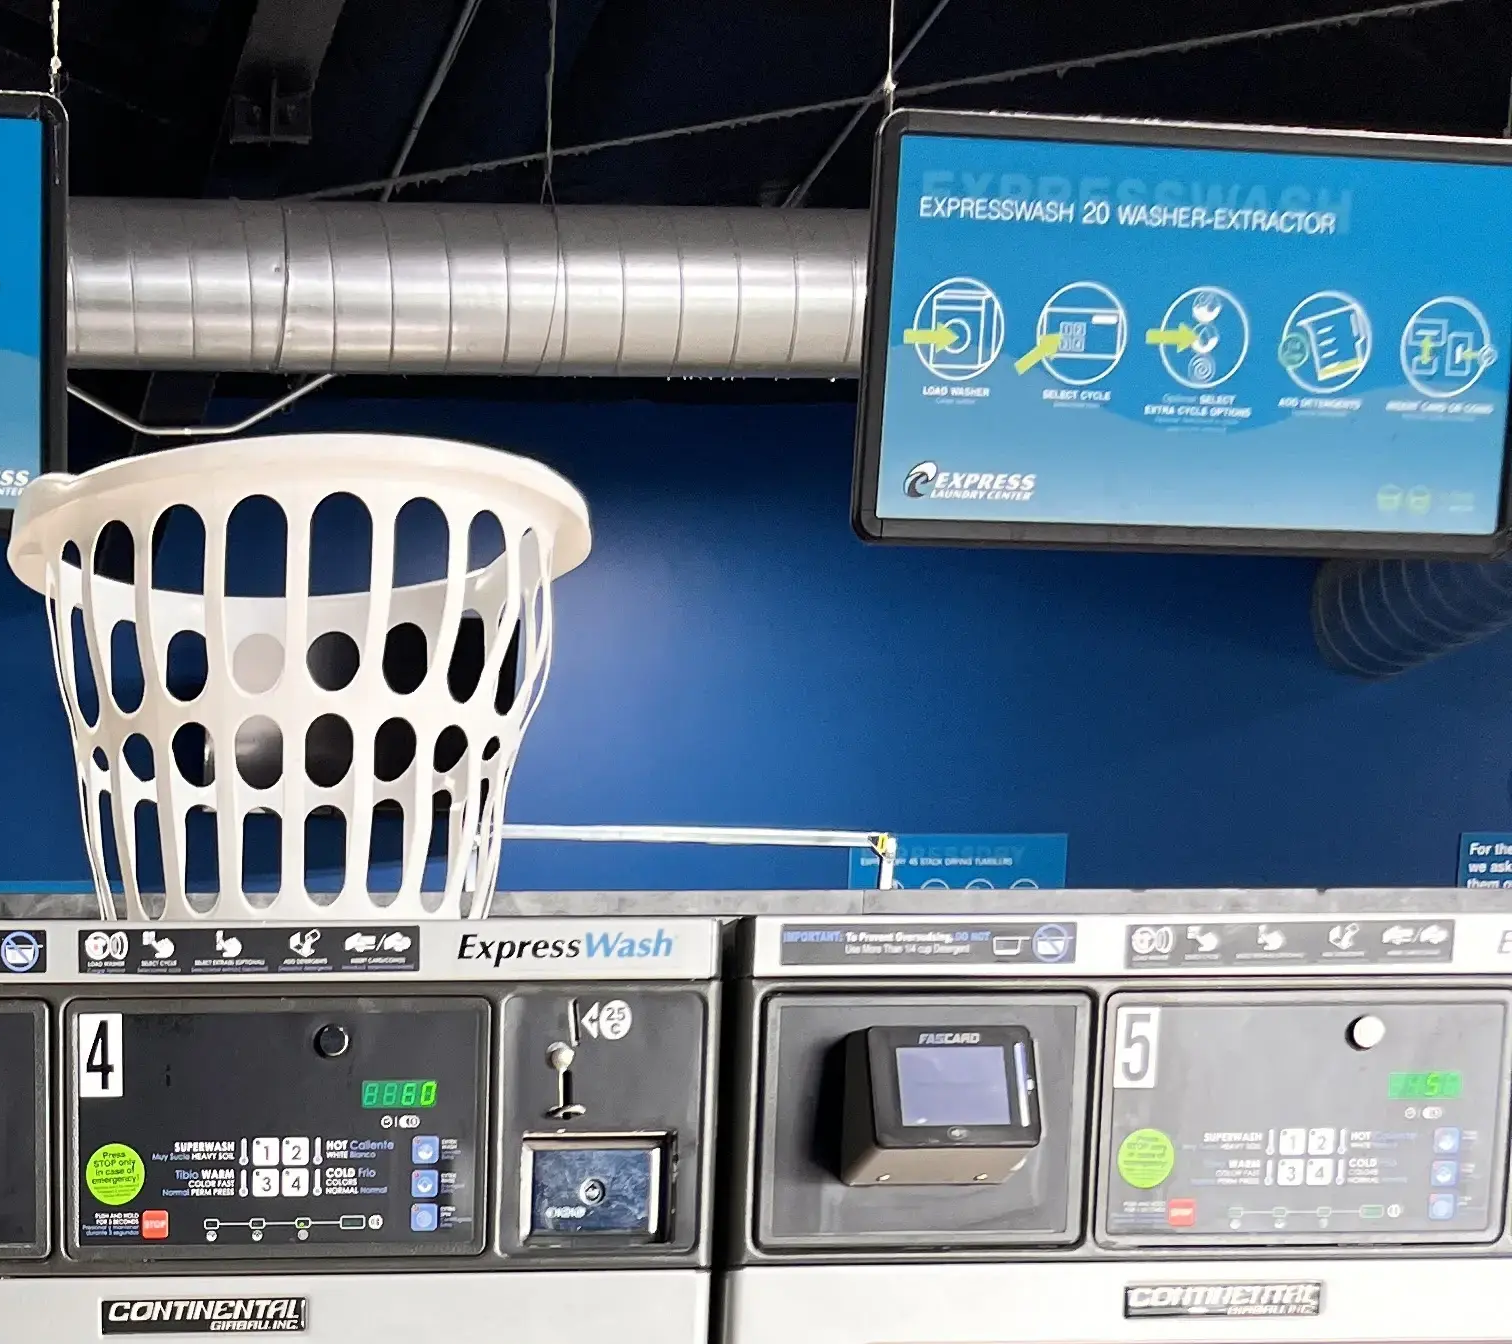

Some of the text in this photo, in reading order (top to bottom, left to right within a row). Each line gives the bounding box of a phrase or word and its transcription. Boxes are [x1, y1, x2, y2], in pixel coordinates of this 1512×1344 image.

[919, 195, 1336, 235] EXPRESSWASH 20 WASHER-EXTRACTOR
[1042, 389, 1078, 400] SELECT
[935, 472, 1037, 491] EXPRESS
[930, 489, 1034, 501] LAUNDRY CENTER
[1470, 842, 1492, 856] For
[1468, 862, 1487, 873] we
[606, 1007, 626, 1021] 25
[919, 1032, 980, 1044] FASCARD
[1122, 1013, 1151, 1082] 5
[86, 1020, 115, 1090] 4
[1203, 1132, 1262, 1143] SUPERWASH
[174, 1141, 235, 1153] SUPERWASH
[326, 1140, 348, 1151] HOT
[1349, 1158, 1378, 1168] COLD
[326, 1168, 356, 1178] COLD
[108, 1299, 300, 1322] CONTINENTAL
